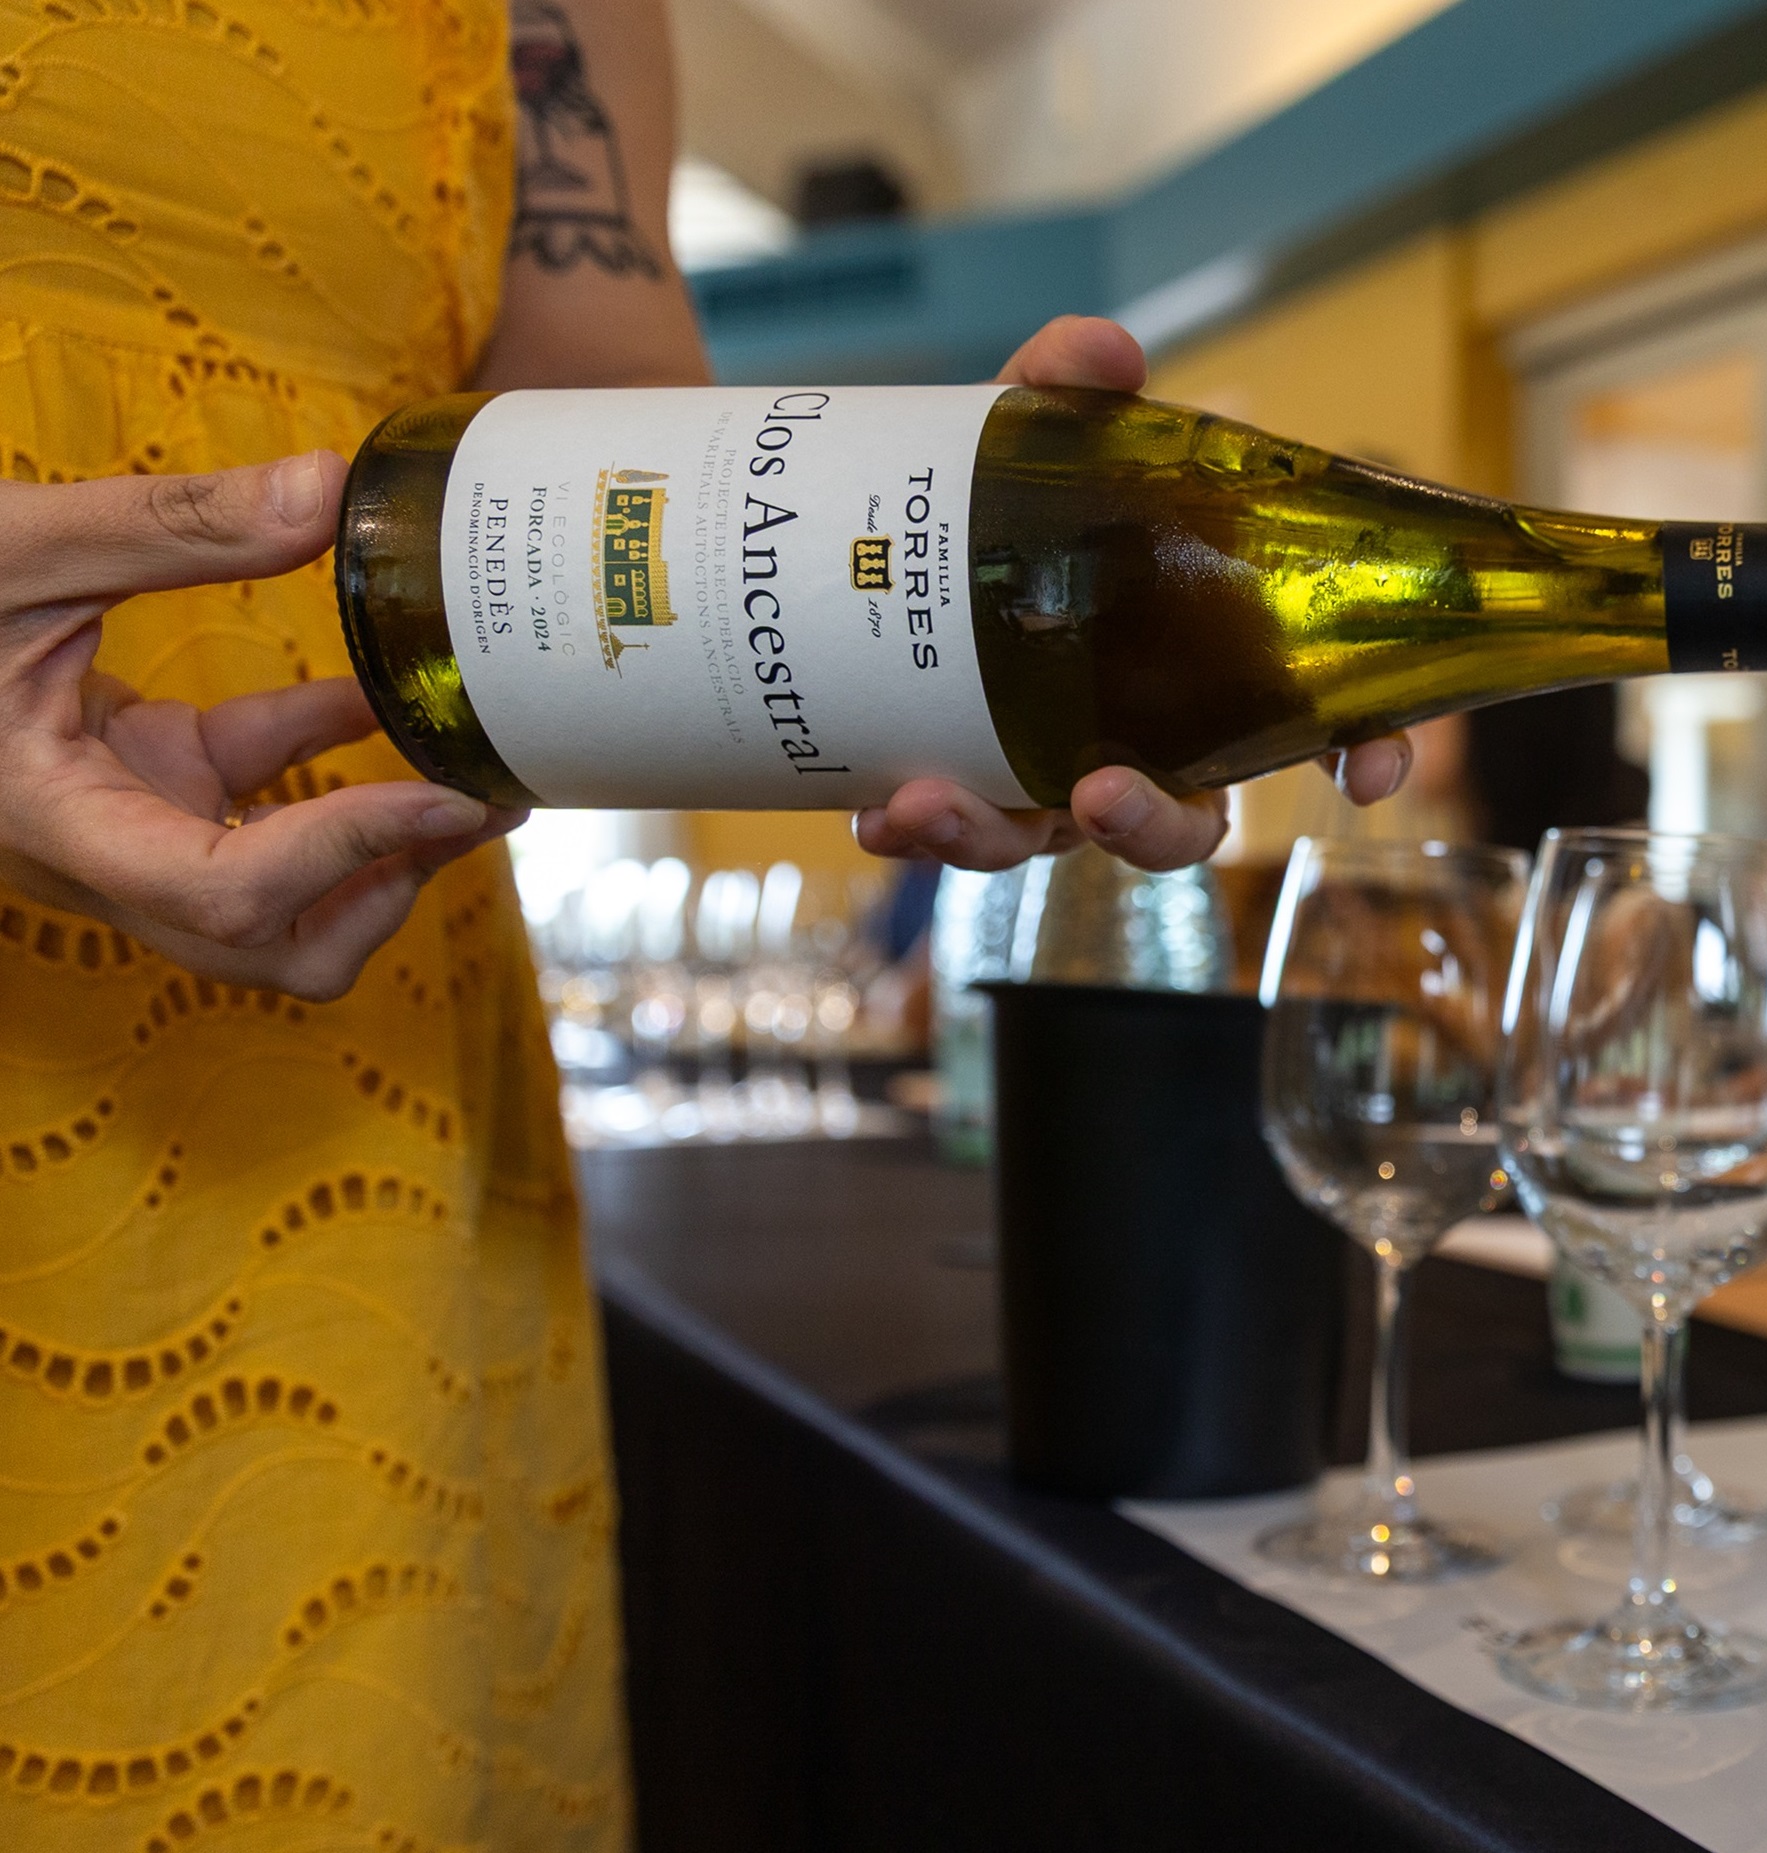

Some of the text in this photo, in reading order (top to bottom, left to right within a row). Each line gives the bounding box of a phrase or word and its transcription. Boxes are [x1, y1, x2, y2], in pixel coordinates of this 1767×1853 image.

[697, 423, 725, 510] VARIETALS
[468, 482, 491, 654] DENOMINACIÓ D'ORIGEN
[486, 498, 515, 635] PENEDÈS
[527, 486, 551, 652] FORCADA 2024
[552, 481, 576, 657] VI ECOLÒGIC
[714, 449, 749, 696] PROJECTE DE RECUPERACIÓ
[743, 392, 851, 775] Clos Ancestral
[866, 494, 882, 638] Desde 1870
[904, 466, 939, 670] TORRES
[938, 522, 951, 608] FAMILIA
[702, 635, 745, 745] ANCESTRALS
